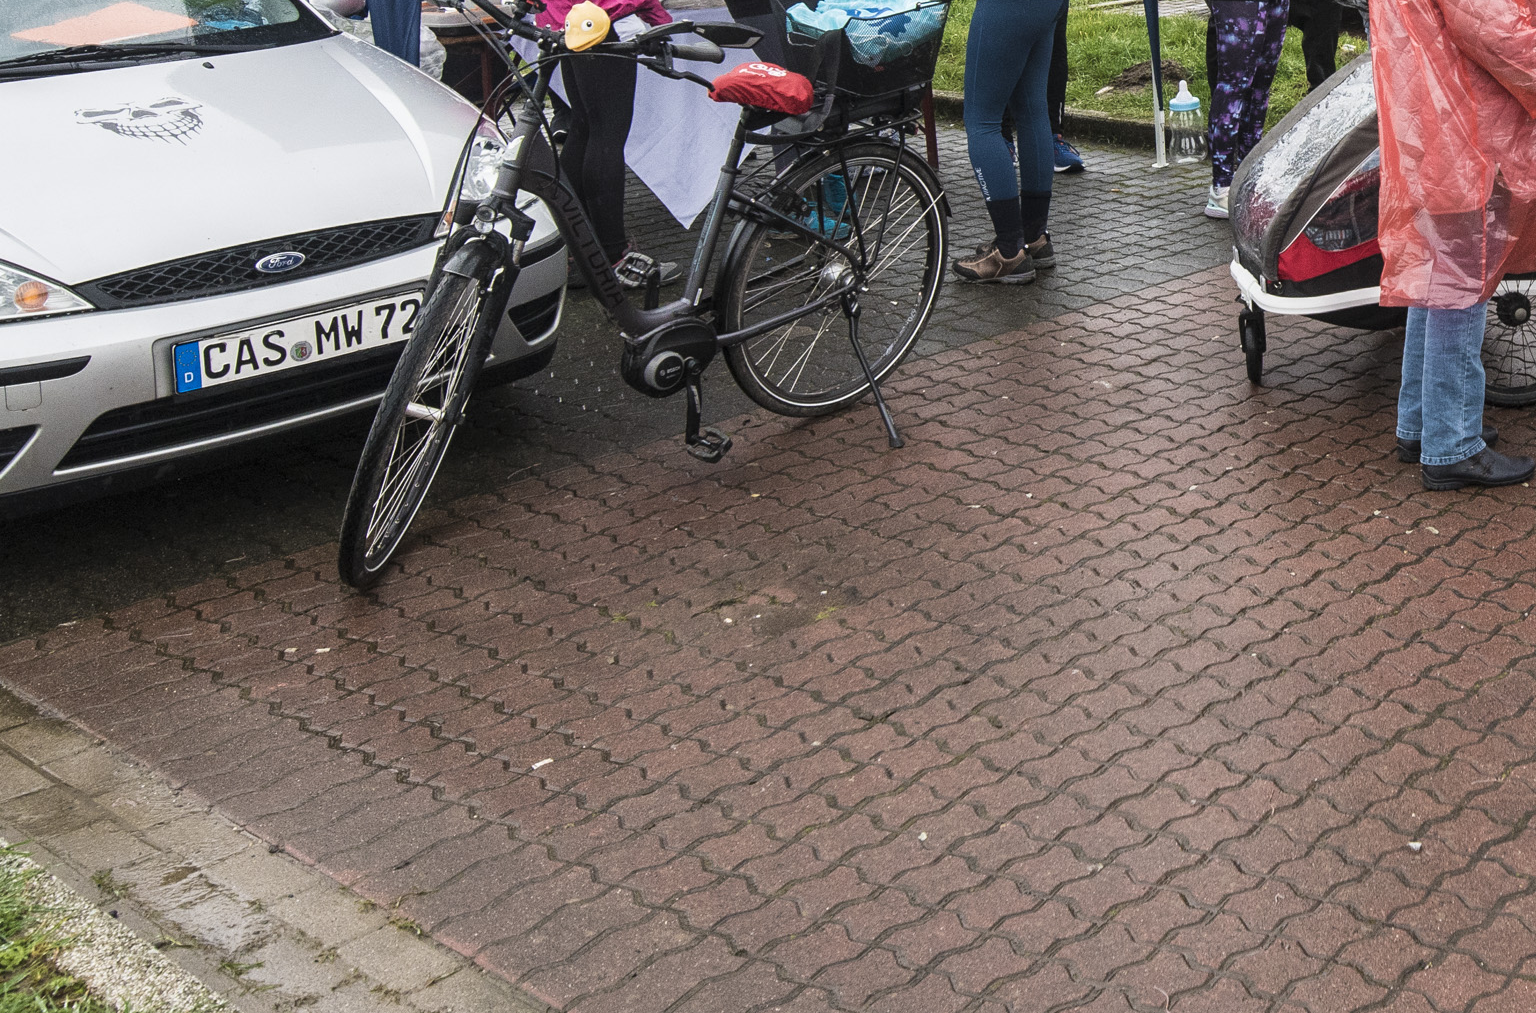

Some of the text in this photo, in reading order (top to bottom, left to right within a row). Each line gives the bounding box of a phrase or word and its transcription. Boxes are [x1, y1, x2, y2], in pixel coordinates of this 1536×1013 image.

[268, 255, 294, 269] Ford
[202, 298, 421, 379] CAS MW 72
[184, 371, 194, 384] D
